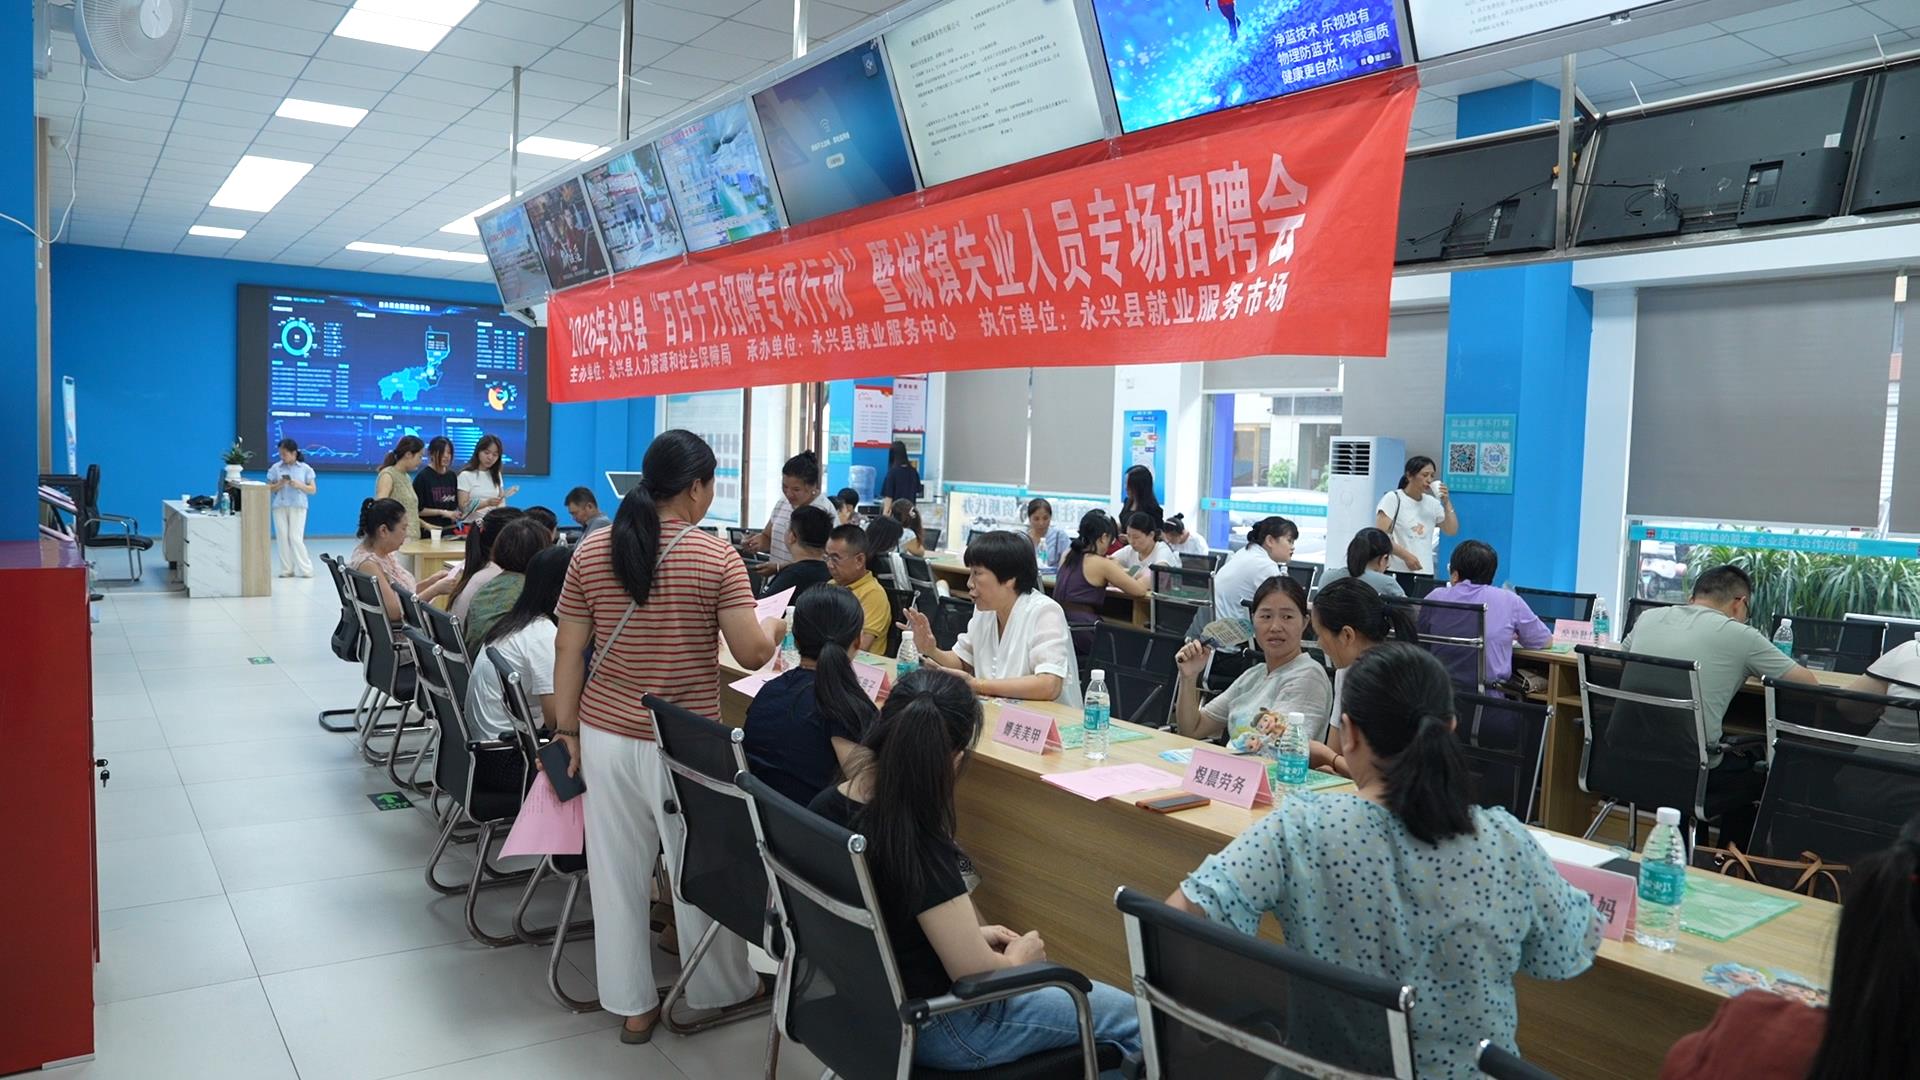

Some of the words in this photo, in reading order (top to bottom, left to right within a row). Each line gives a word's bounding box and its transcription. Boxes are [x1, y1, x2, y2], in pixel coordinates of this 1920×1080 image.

[1273, 23, 1320, 48] 净蓝技术
[1321, 7, 1370, 35] 乐视独有
[1277, 39, 1336, 66] 物理防蓝光
[1339, 22, 1390, 49] 不损画质
[746, 313, 957, 362] 承办单位：永兴县就业服务中心
[978, 271, 1290, 338] 执行单位：永兴县就业服务市场
